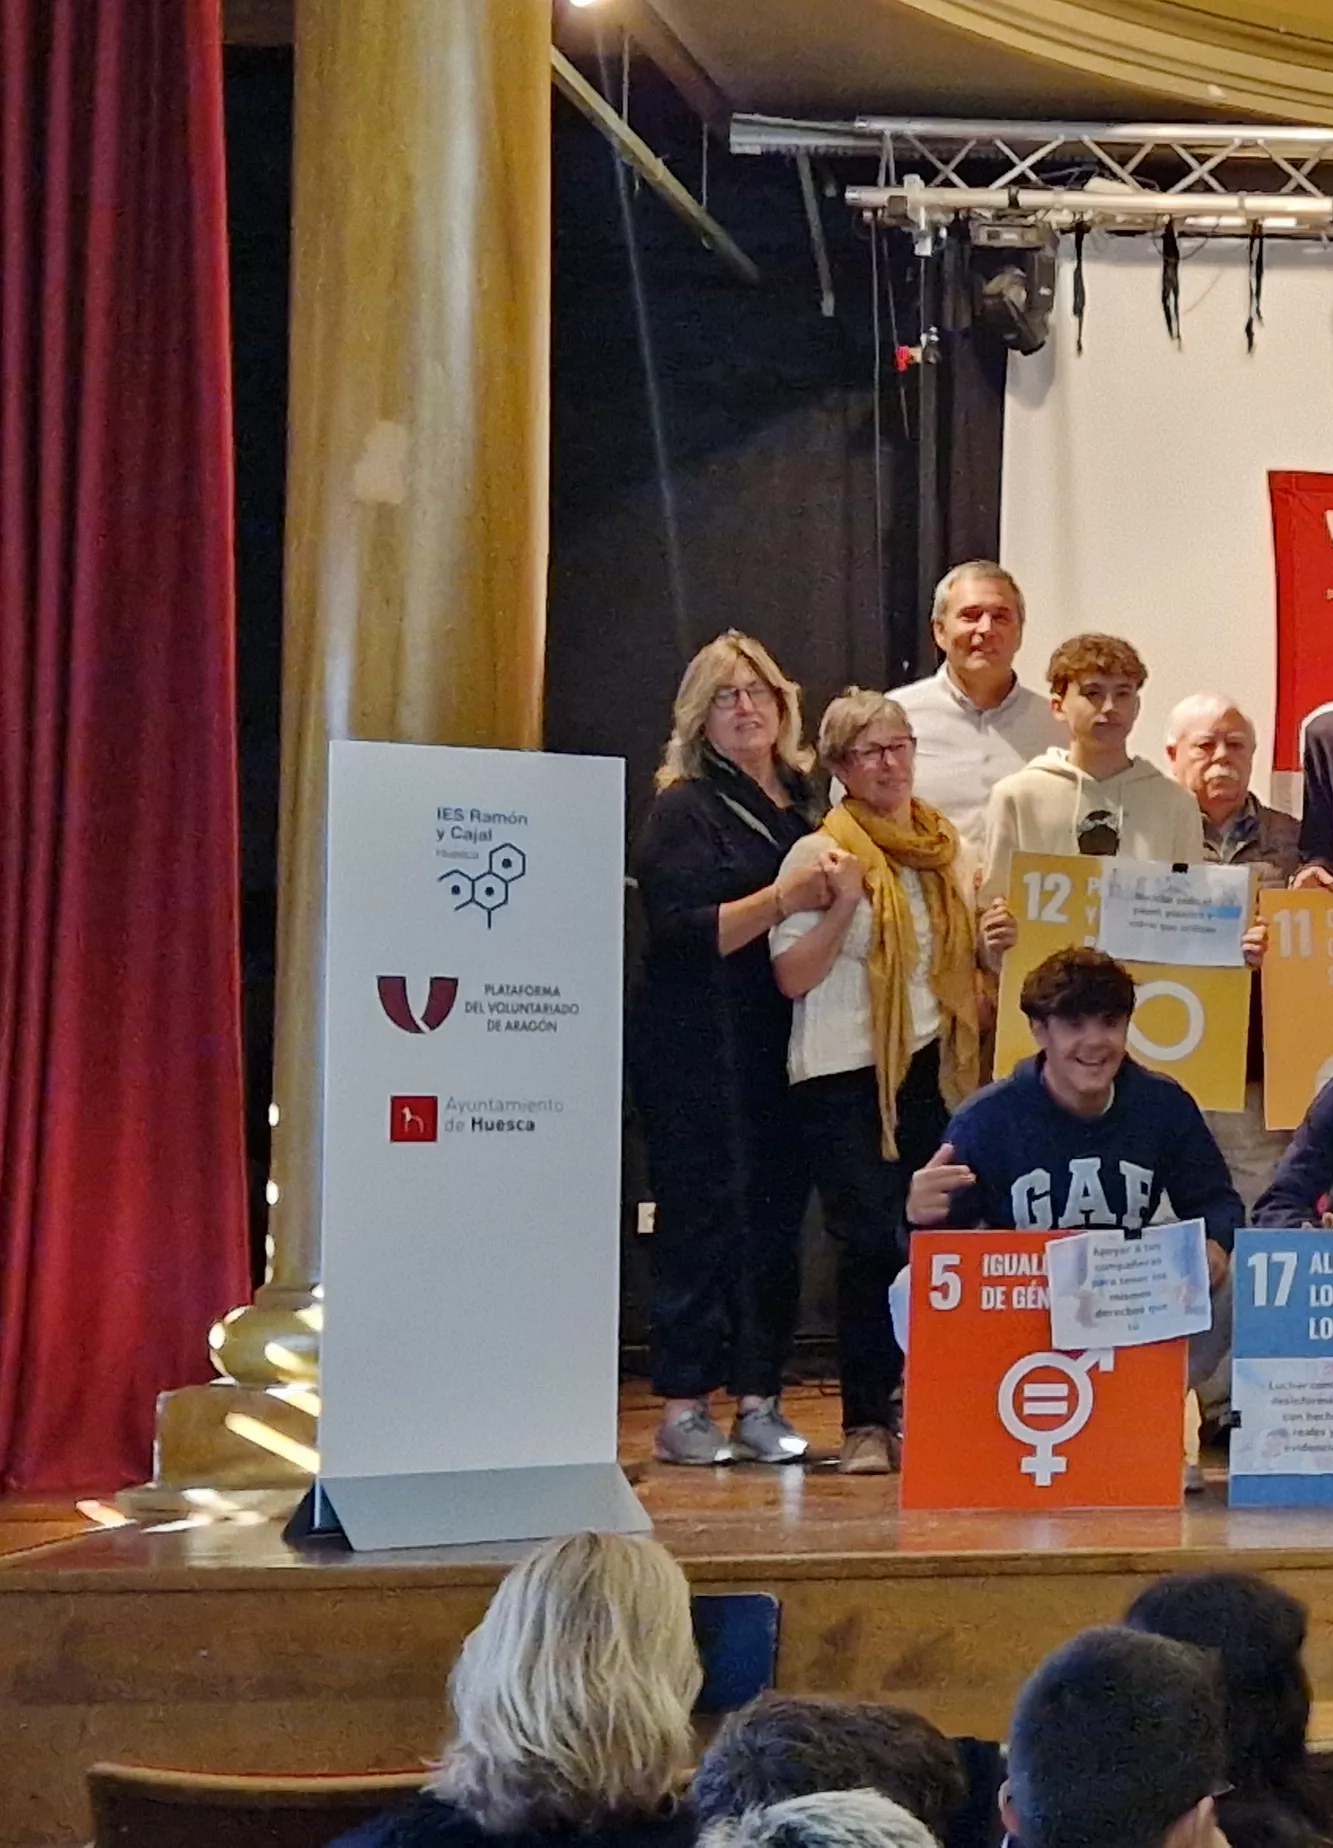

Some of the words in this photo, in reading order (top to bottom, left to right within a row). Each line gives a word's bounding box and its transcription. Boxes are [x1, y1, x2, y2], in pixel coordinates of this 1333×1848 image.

[436, 806, 465, 821] IES
[470, 808, 529, 826] Ramón
[436, 828, 446, 842] y
[450, 825, 493, 845] Cajal
[1022, 871, 1073, 924] 12
[1273, 908, 1314, 959] 11
[484, 984, 562, 998] PLATAFORMA
[465, 1001, 485, 1014] DEL
[488, 1001, 580, 1015] VOLUNTARIADO
[487, 1019, 501, 1033] DE
[504, 1018, 558, 1034] ARAGÓN
[445, 1095, 565, 1115] Ayuntamiento
[444, 1118, 466, 1133] de
[470, 1116, 537, 1133] Huesca
[928, 1253, 963, 1312] 5
[1247, 1252, 1299, 1308] 17
[980, 1285, 1007, 1311] DE
